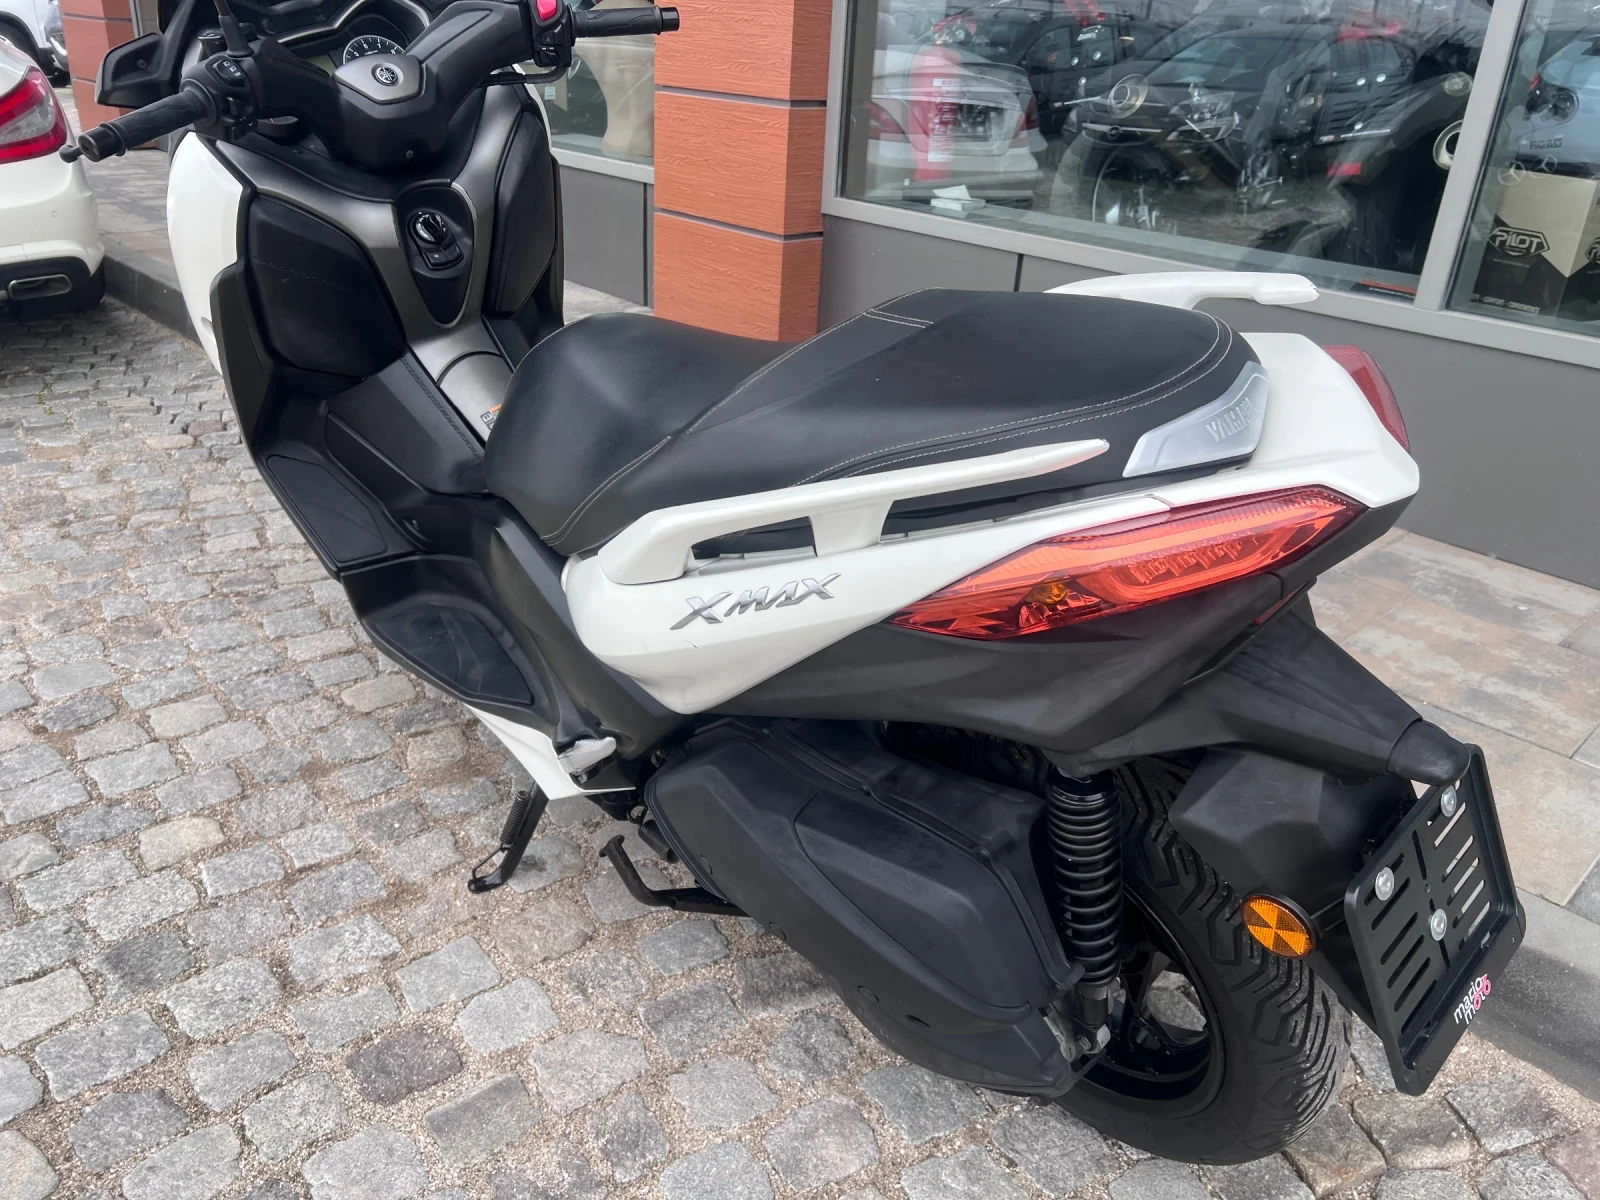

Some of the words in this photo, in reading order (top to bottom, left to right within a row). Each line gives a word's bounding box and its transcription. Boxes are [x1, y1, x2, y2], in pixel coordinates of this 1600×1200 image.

[670, 572, 842, 631] XMAX
[1453, 976, 1483, 1025] mario
[1464, 973, 1492, 1026] moto
